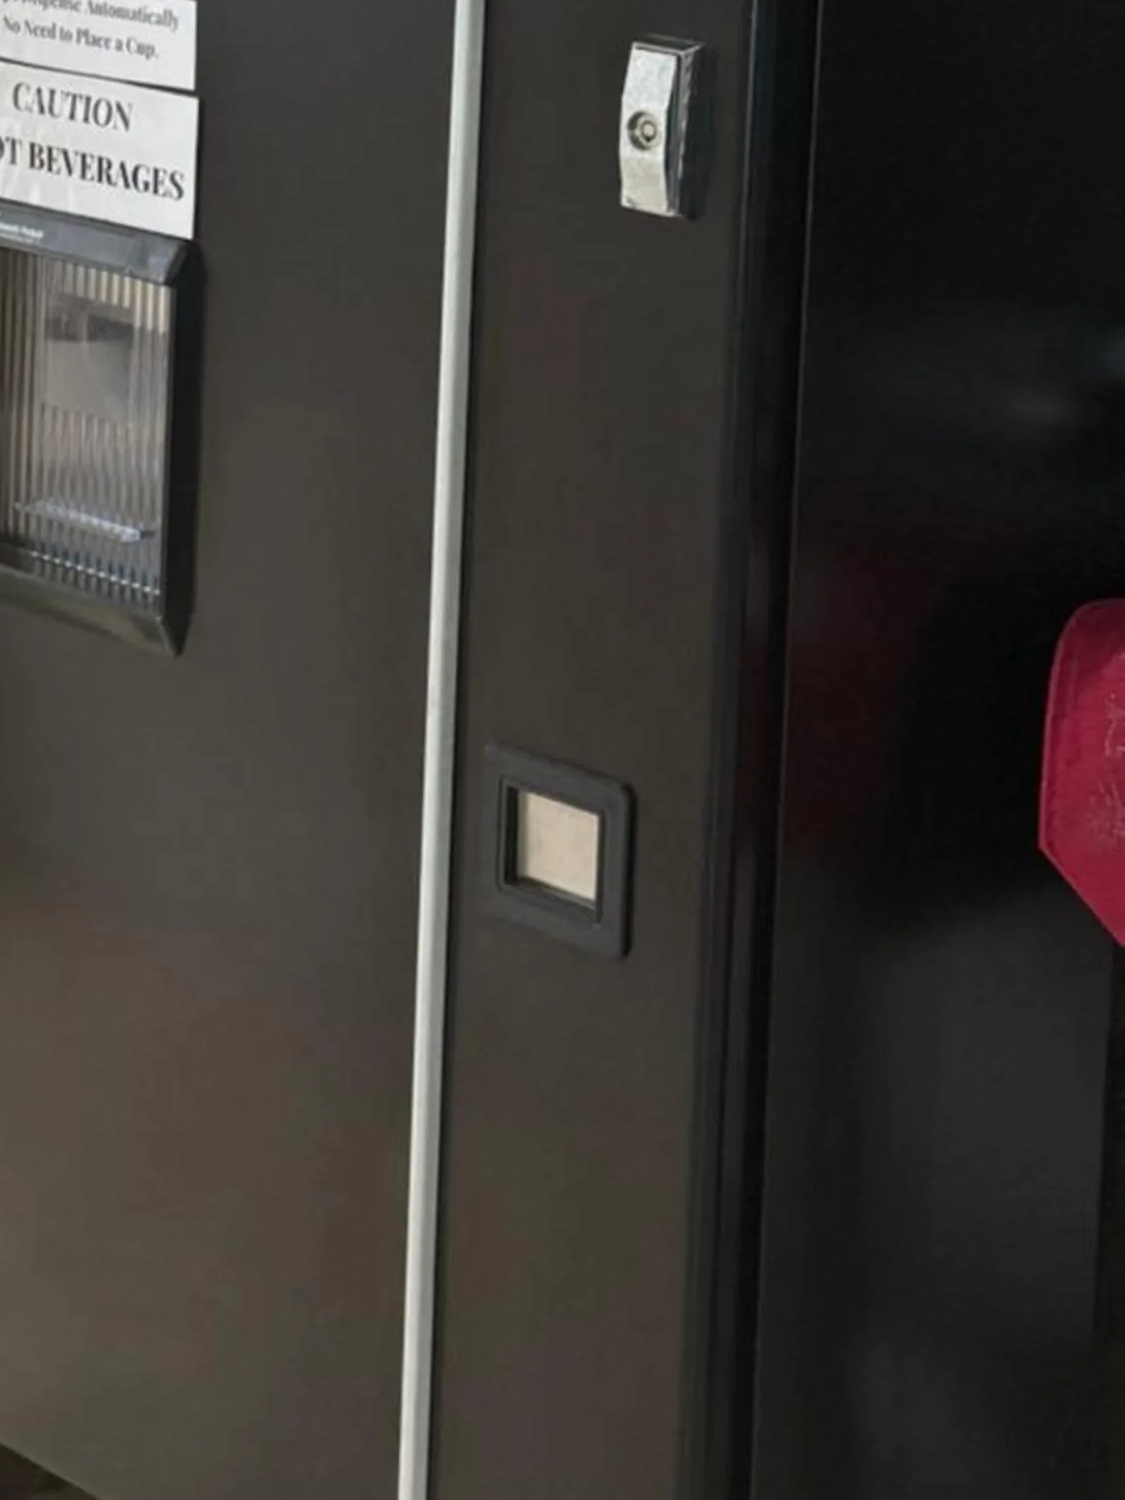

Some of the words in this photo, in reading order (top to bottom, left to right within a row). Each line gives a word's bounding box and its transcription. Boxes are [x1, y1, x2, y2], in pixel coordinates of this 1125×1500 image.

[2, 15, 21, 34] No
[24, 21, 58, 41] Need
[59, 27, 73, 44] to
[76, 29, 111, 51] Place
[115, 40, 123, 52] a
[126, 38, 158, 61] Cup.
[87, 0, 179, 32] Automatically
[11, 81, 134, 133] CAUTION
[28, 141, 186, 202] BEVERAGES
